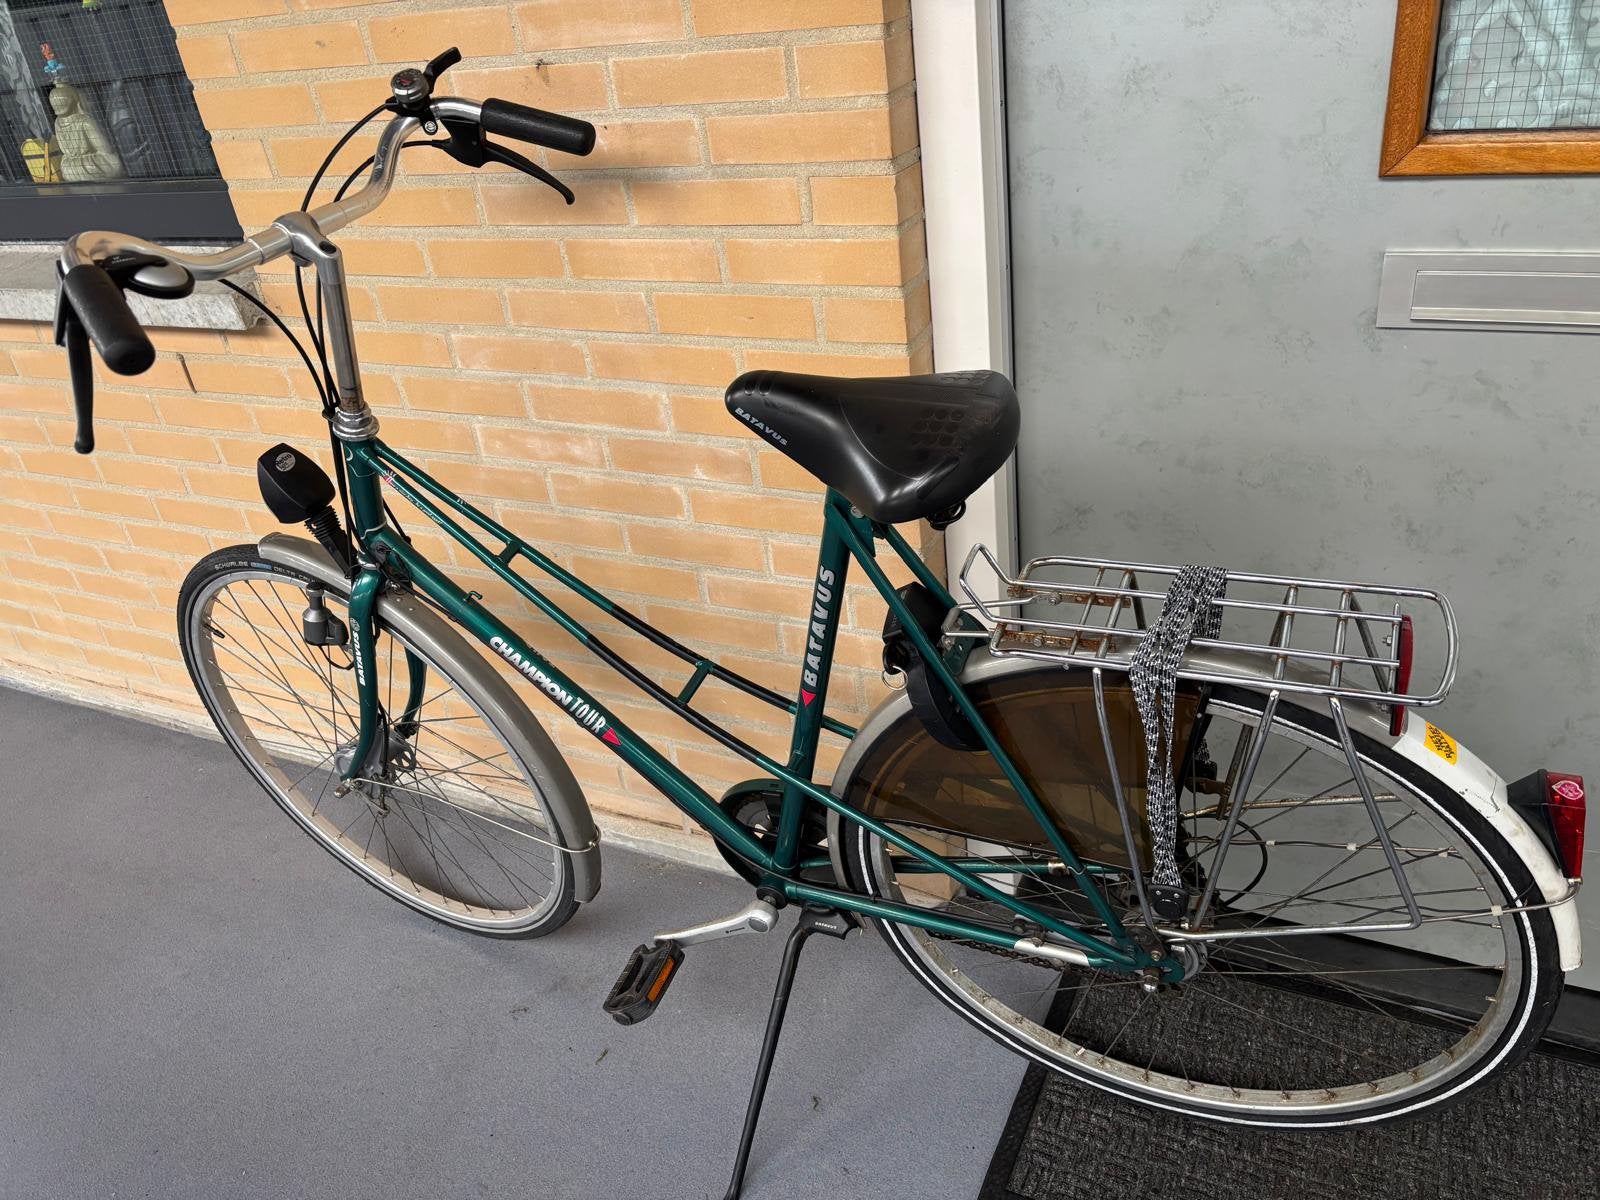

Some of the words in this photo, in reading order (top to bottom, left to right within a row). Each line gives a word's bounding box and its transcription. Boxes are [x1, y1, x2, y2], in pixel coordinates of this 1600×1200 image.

[734, 407, 788, 447] BATAVUS
[214, 561, 249, 570] SCHWALBE
[273, 566, 296, 577] DELTA
[803, 565, 835, 688] BATAVUS
[352, 630, 366, 687] BATAVUS
[489, 636, 574, 706] CHAMPION
[569, 696, 607, 734] TOUR
